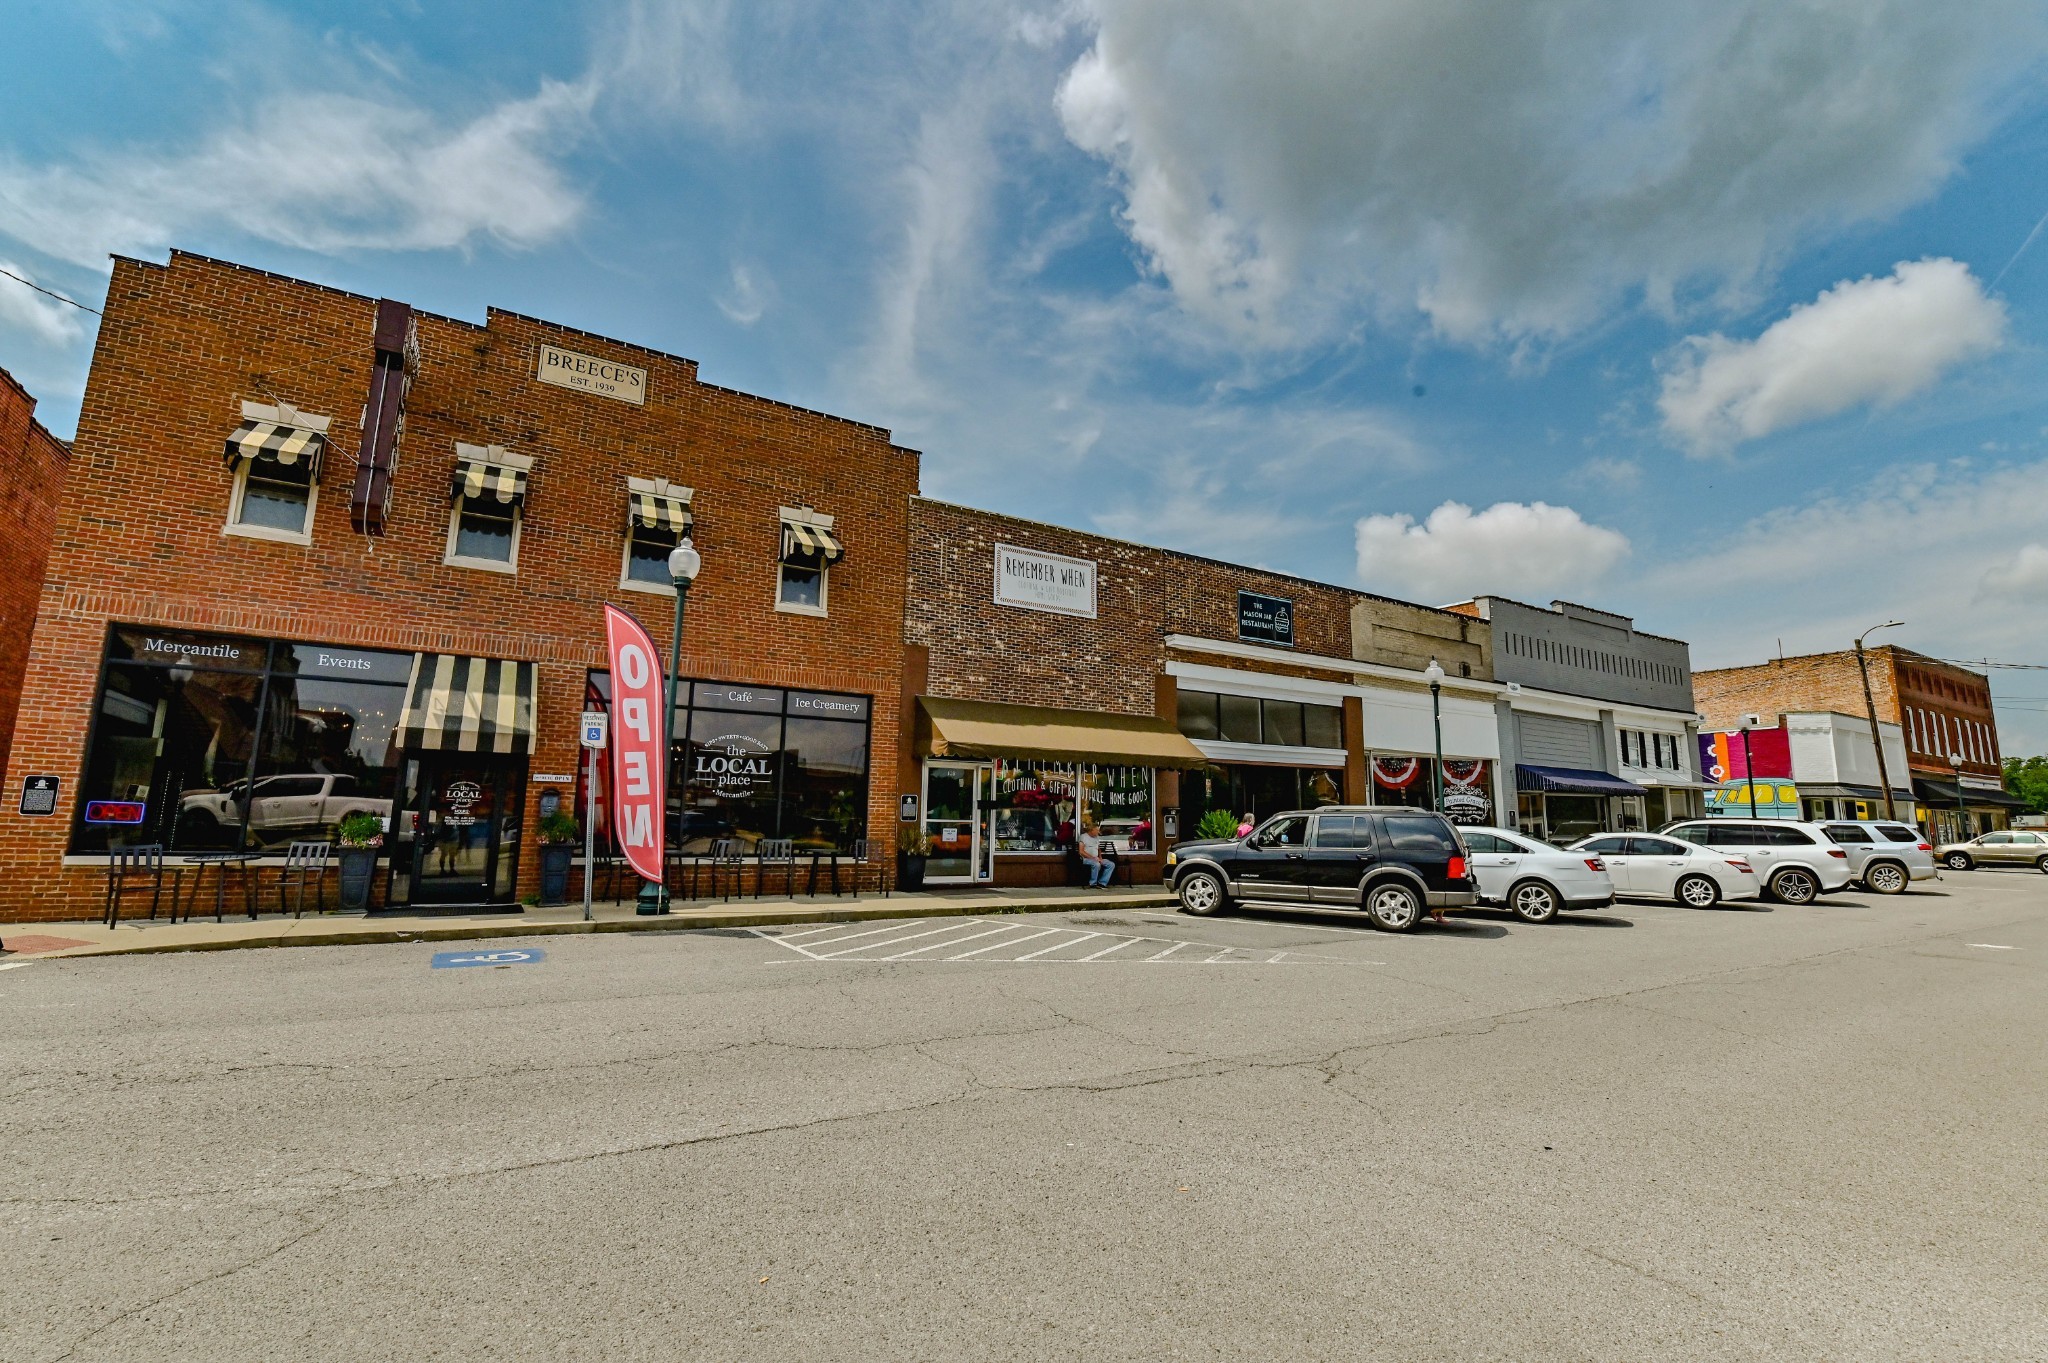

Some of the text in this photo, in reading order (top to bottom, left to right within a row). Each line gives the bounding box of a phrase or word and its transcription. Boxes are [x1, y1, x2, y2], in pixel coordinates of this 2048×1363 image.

[547, 352, 640, 387] BREECE'S
[570, 376, 615, 392] EST. 1939
[1006, 556, 1085, 588] REMEMBER WHEN
[1243, 610, 1263, 618] MASON
[1241, 619, 1274, 630] RESTAURANT
[143, 638, 240, 659] Mercantile
[317, 654, 371, 670] Events
[728, 691, 753, 703] Café
[795, 698, 860, 713] Ice Creamery
[726, 744, 746, 757] the
[695, 756, 773, 775] LOCAL
[718, 773, 751, 788] place
[1106, 765, 1149, 788] WHEN
[446, 790, 482, 799] LOCAL
[715, 789, 751, 799] Mercantile
[1002, 777, 1037, 794] CLOTHING
[1040, 780, 1046, 790] &
[1109, 791, 1125, 805] HOME
[1128, 788, 1148, 805] GOODS
